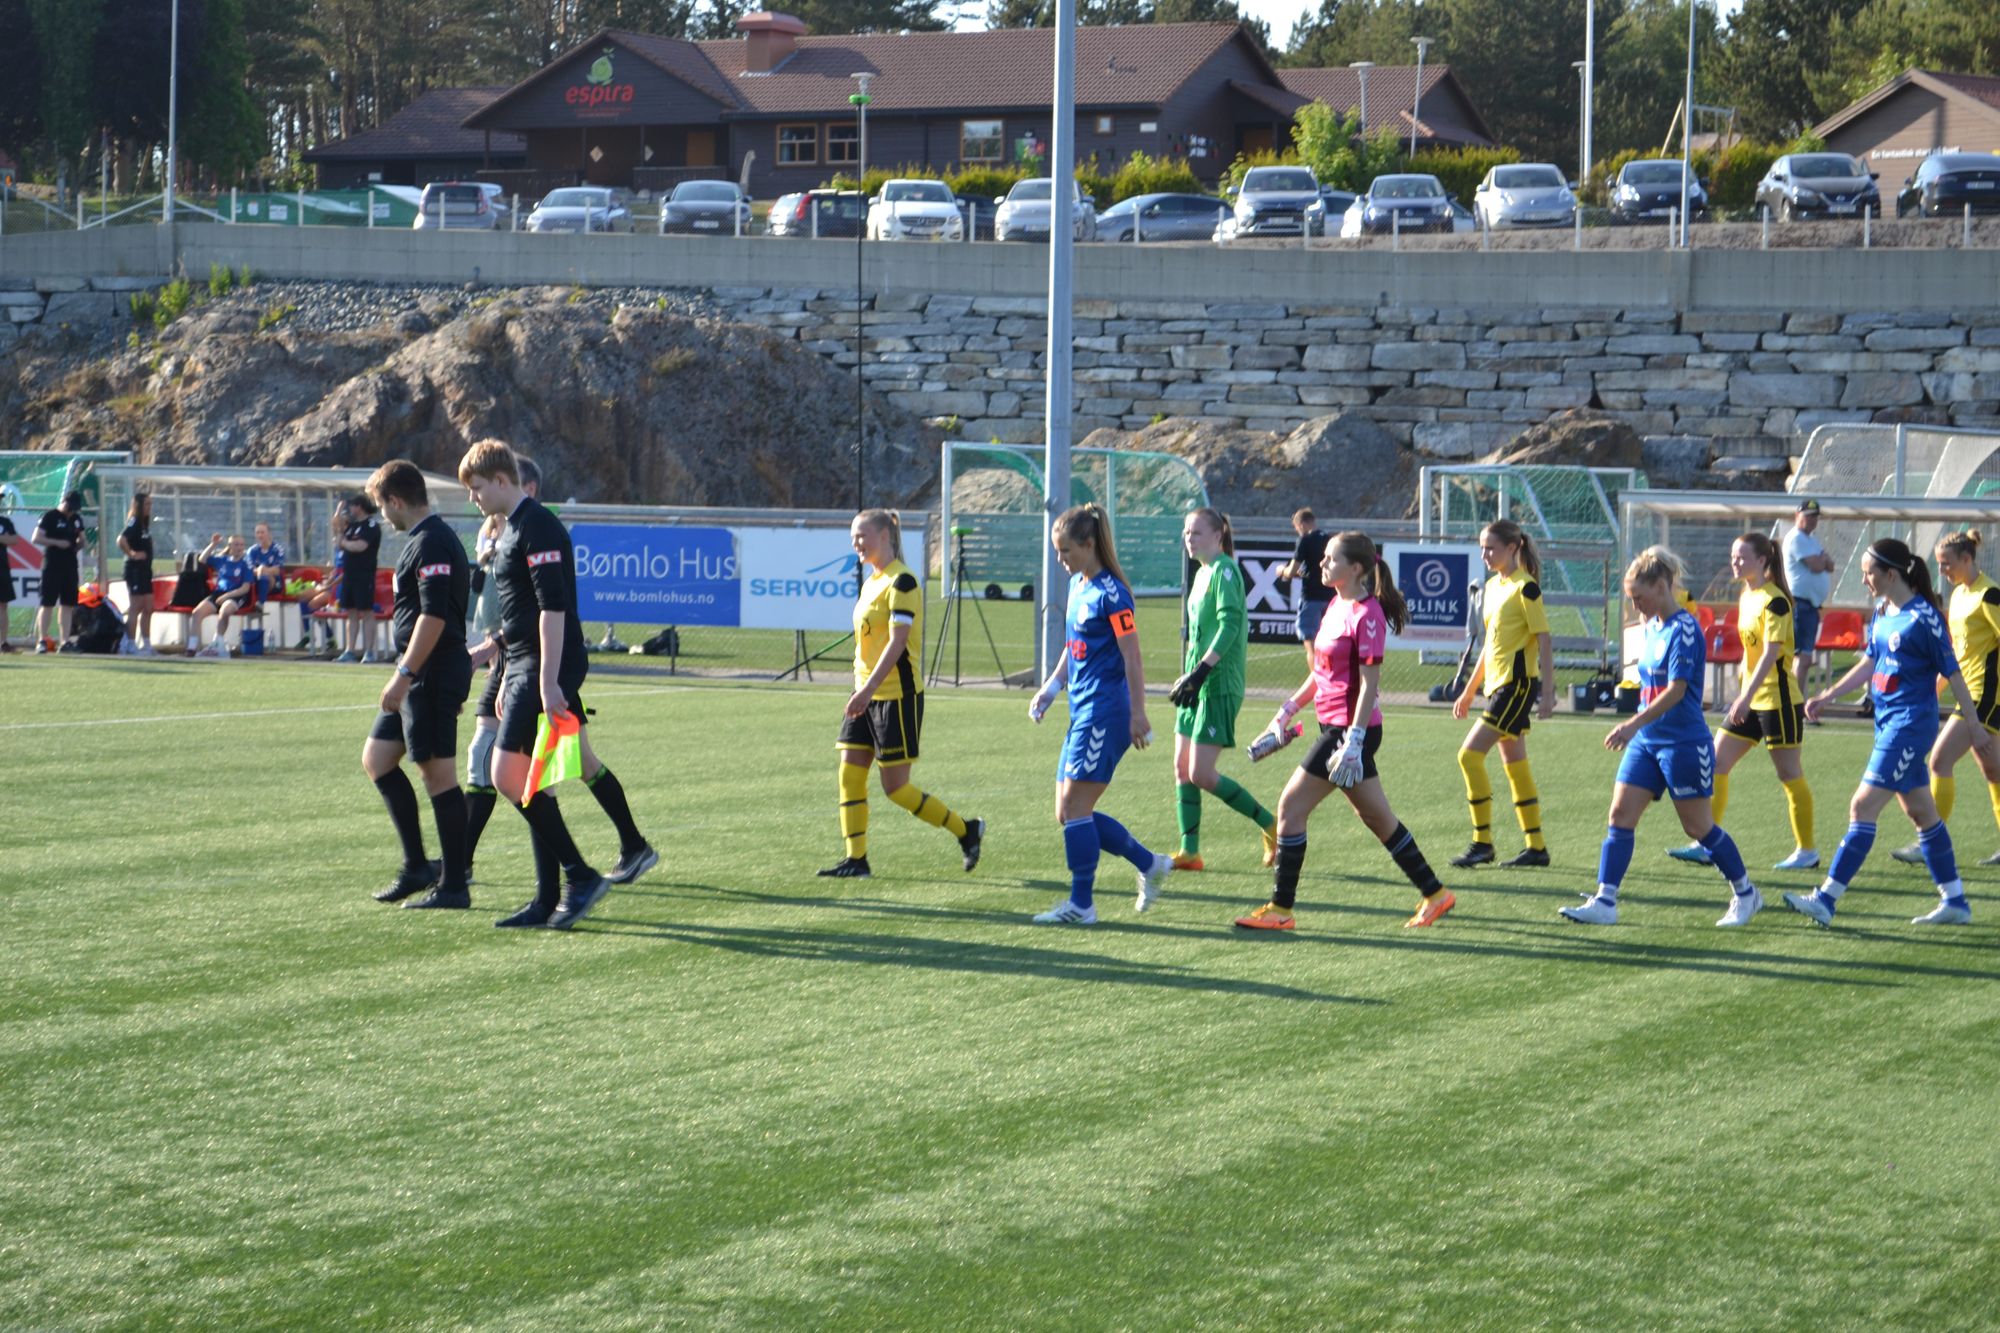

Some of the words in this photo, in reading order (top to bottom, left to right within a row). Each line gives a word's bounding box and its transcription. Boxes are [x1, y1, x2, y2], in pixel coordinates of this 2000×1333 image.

[565, 84, 634, 107] espira
[530, 551, 561, 566] VG
[574, 545, 670, 579] Bømlo
[679, 547, 737, 580] Hus
[421, 564, 451, 577] VG
[751, 578, 858, 598] SERVOG
[593, 589, 715, 605] www.bomlohus.no
[1407, 599, 1459, 614] BLINK
[1119, 613, 1134, 632] C
